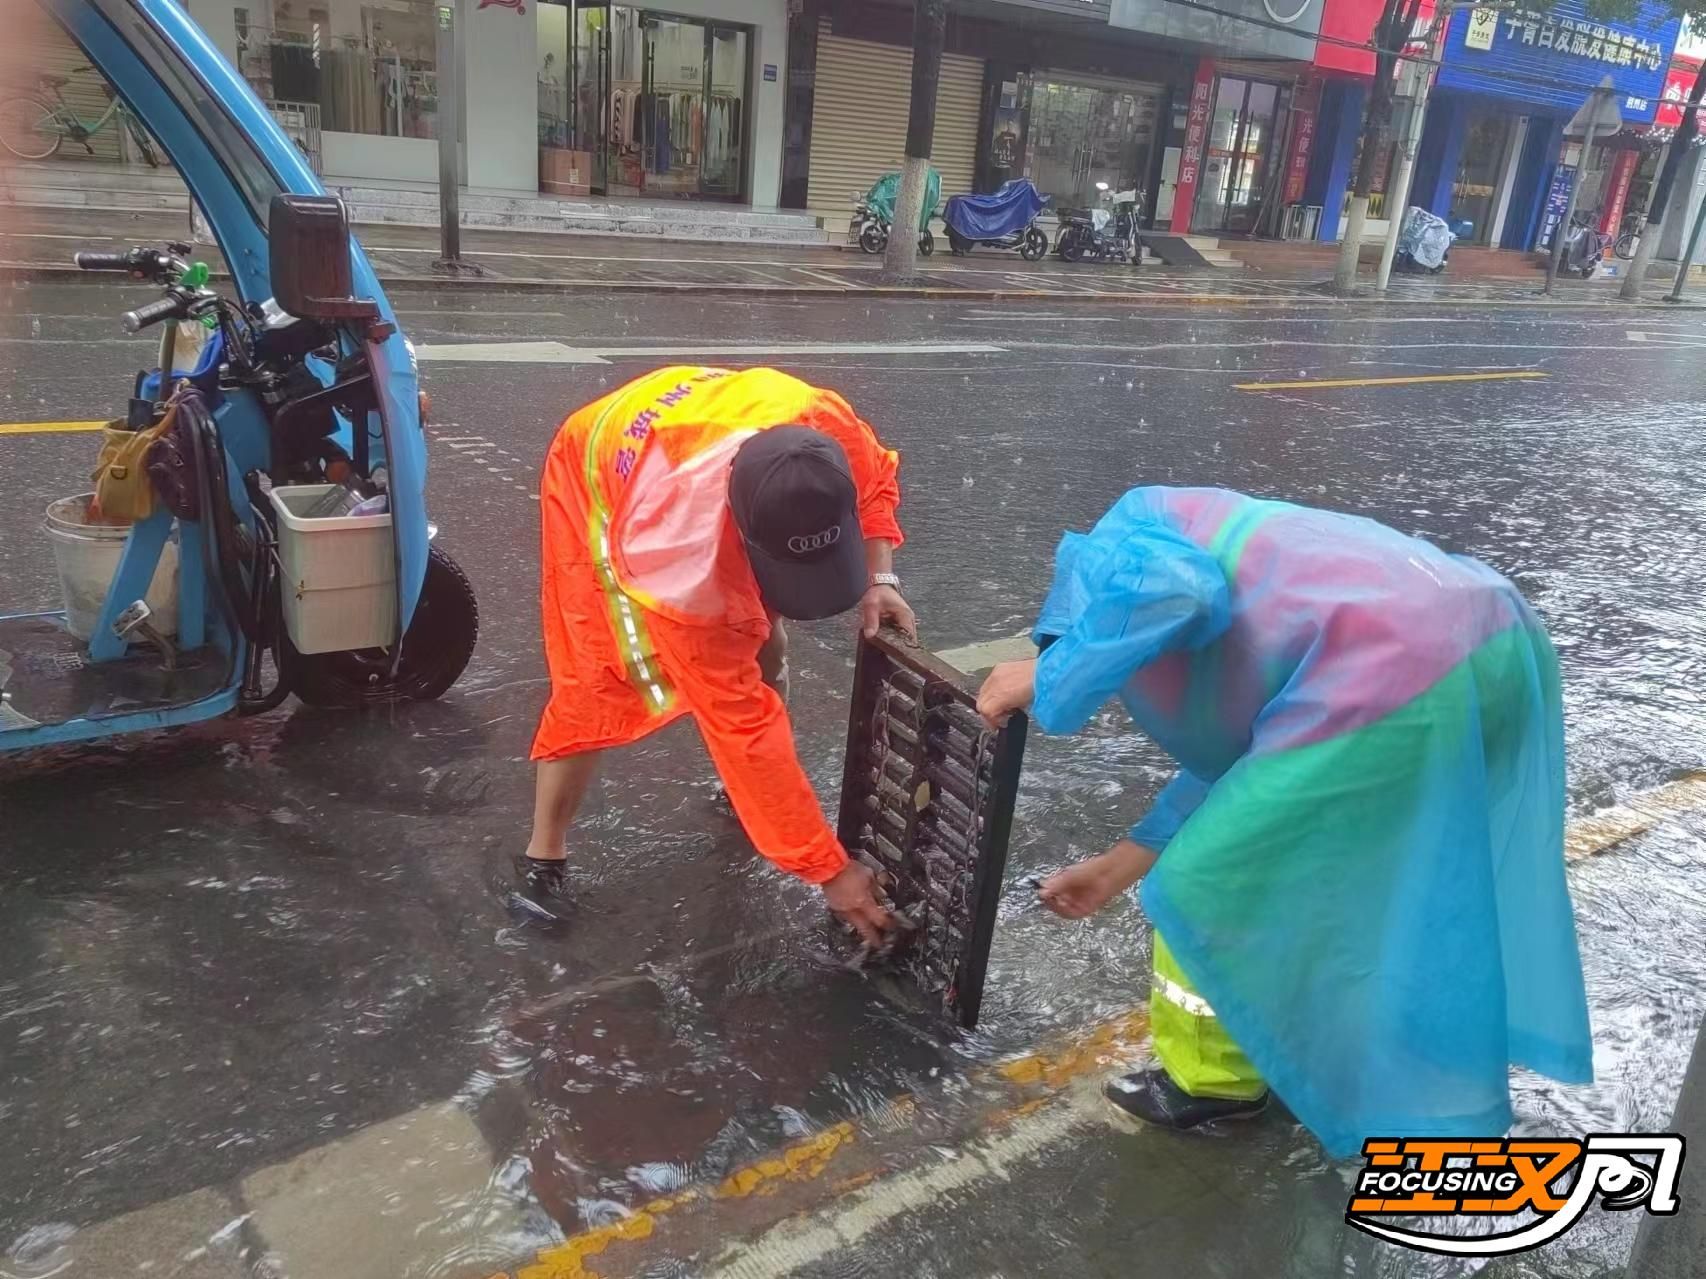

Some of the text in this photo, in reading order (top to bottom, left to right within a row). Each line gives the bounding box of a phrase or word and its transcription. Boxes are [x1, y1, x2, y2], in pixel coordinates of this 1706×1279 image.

[1181, 82, 1209, 184] 阳光便利店
